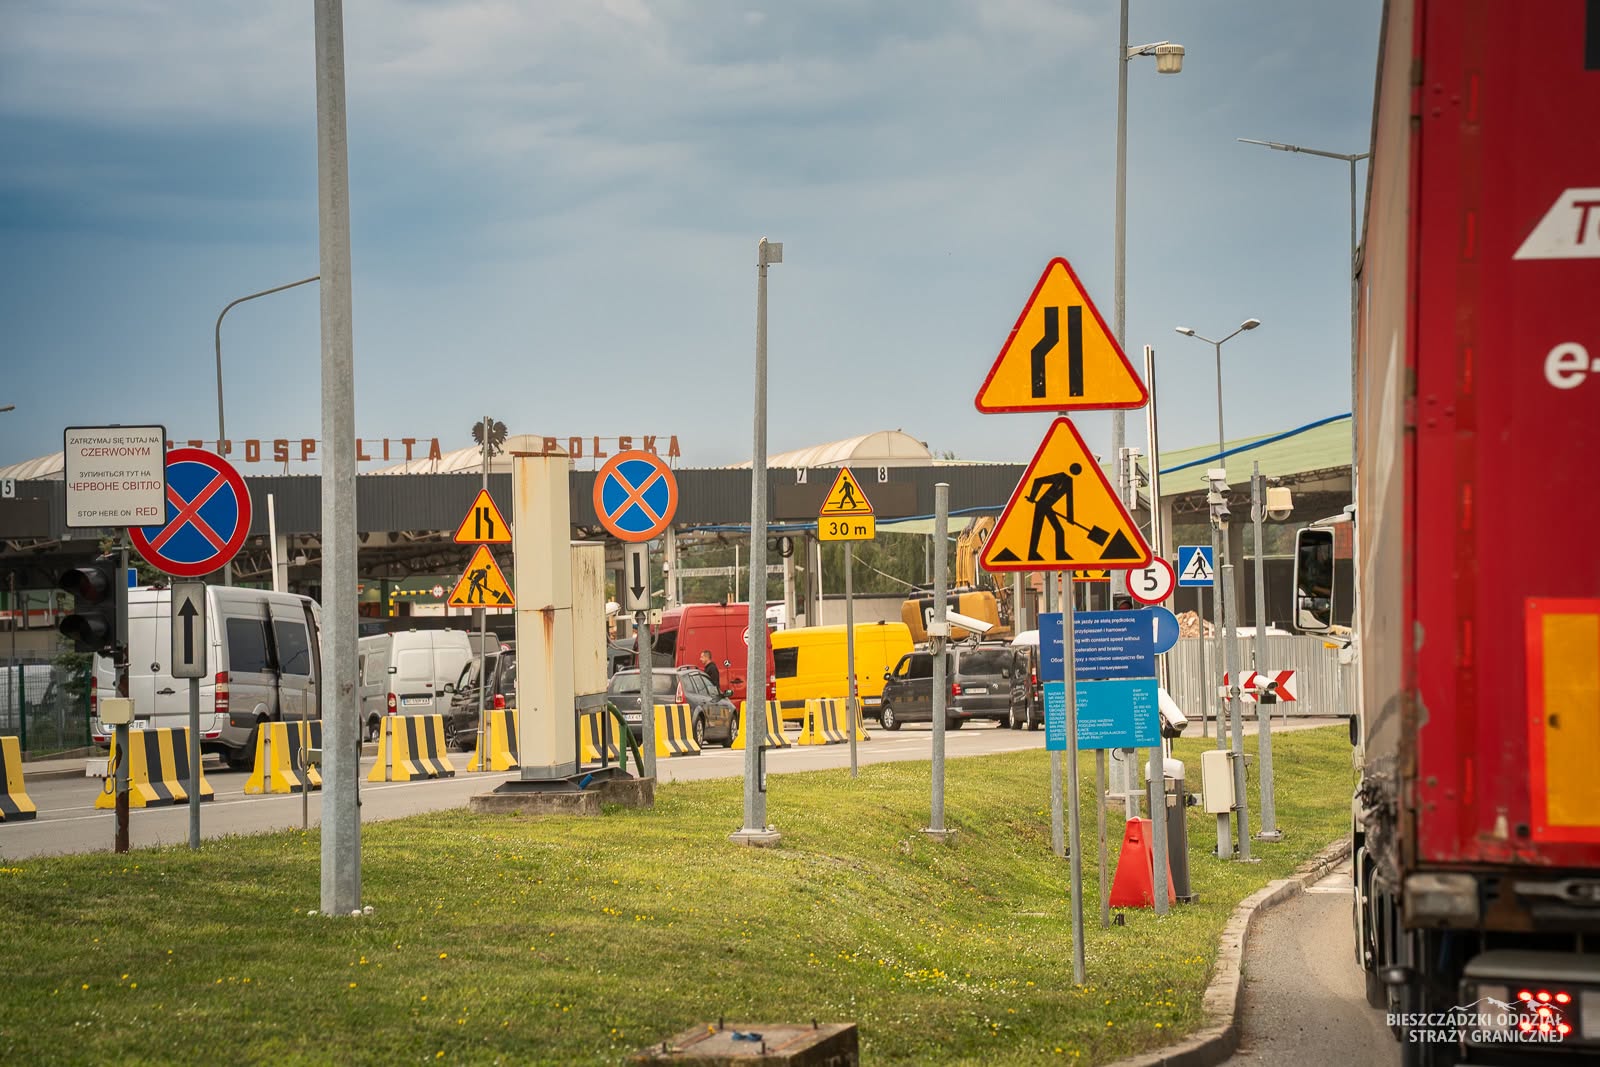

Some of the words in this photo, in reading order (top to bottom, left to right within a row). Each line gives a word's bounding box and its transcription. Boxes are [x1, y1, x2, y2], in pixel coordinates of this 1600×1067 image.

[1572, 200, 1600, 246] T
[81, 447, 150, 456] CZERWONYM
[542, 435, 680, 458] POLSKA
[798, 468, 805, 481] 7
[879, 467, 886, 481] 8
[5, 480, 11, 495] 5
[69, 482, 119, 491] ЧЕРВОНЕ
[122, 481, 161, 490] СВІТЛО
[136, 507, 157, 516] RED
[829, 522, 849, 536] 30
[854, 526, 867, 535] m
[1144, 569, 1158, 591] 5
